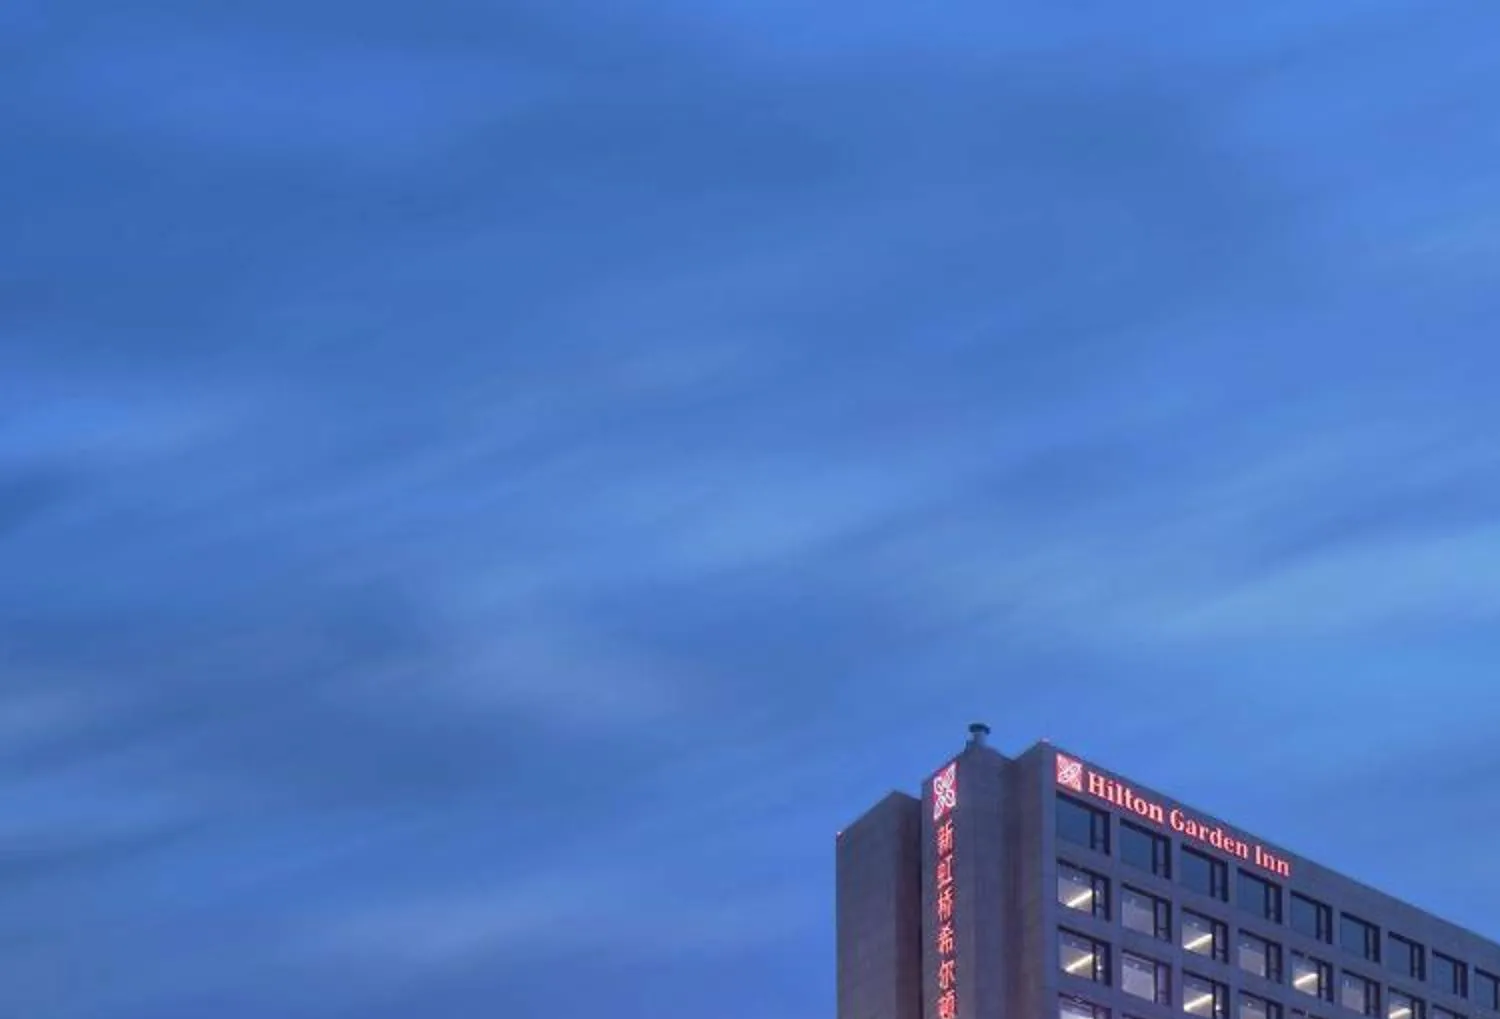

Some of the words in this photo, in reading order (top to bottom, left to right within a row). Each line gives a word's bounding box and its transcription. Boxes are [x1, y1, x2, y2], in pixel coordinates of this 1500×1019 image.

[1088, 771, 1164, 823] Hilton
[1170, 808, 1248, 860] Garden
[1255, 844, 1290, 877] Inn
